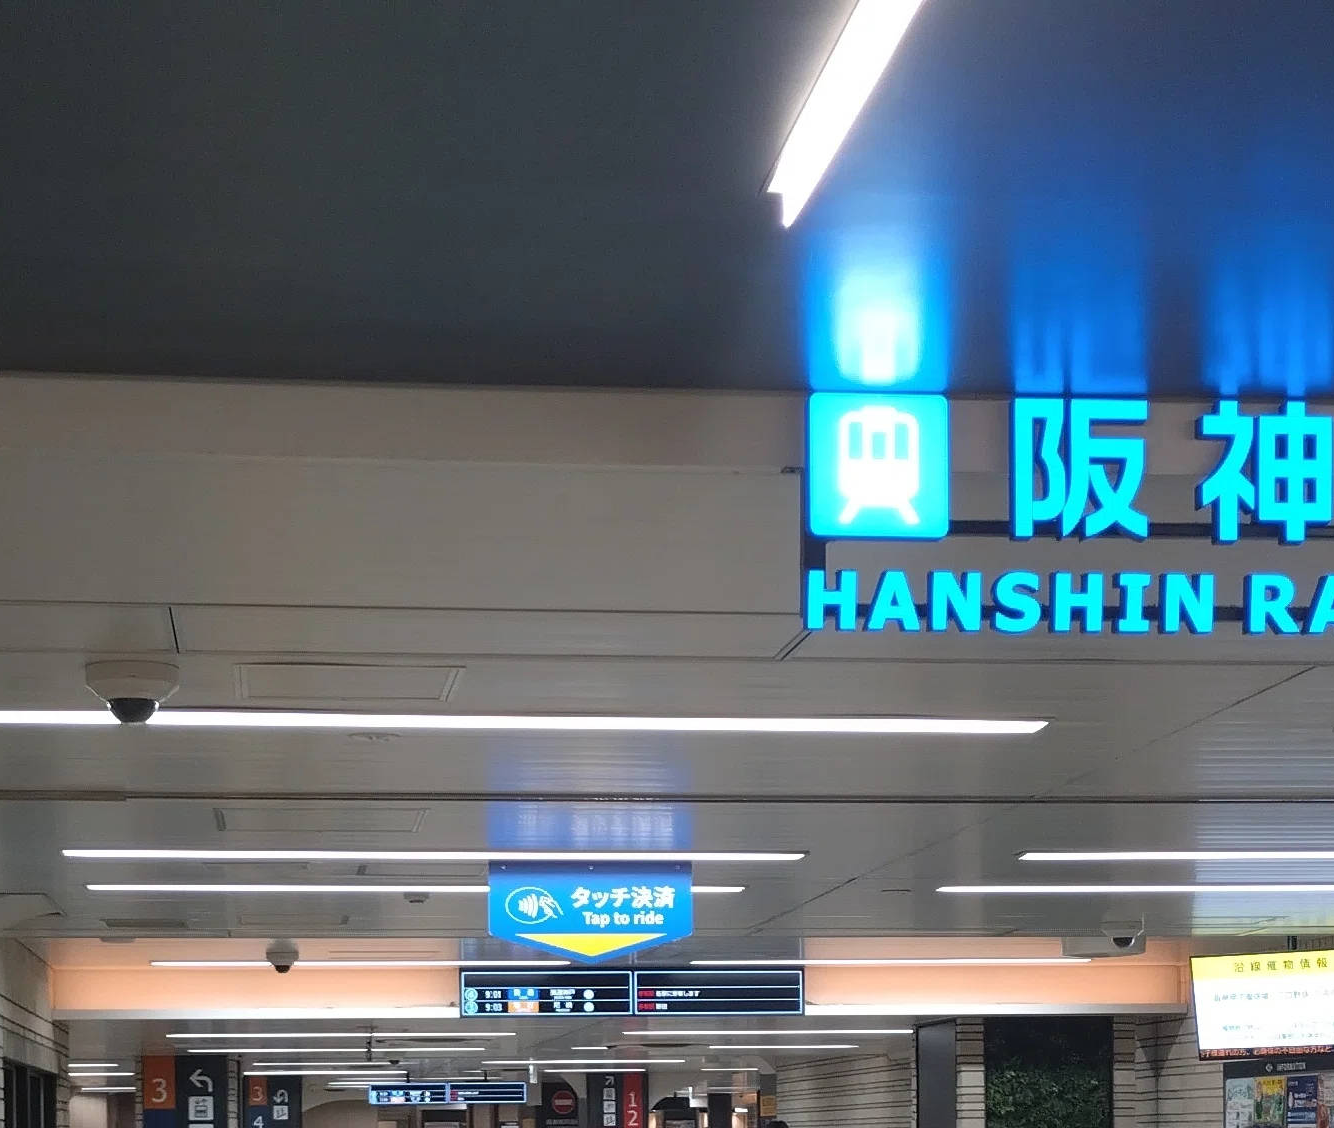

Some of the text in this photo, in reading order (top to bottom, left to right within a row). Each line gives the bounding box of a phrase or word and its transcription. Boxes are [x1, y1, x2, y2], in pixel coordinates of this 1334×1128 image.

[806, 568, 1216, 636] HANSHIN
[570, 886, 676, 909] タッチ決済
[582, 911, 664, 928] Tap to ride
[151, 1077, 168, 1103] 3
[252, 1085, 264, 1101] 3
[629, 1091, 638, 1108] 1
[627, 1110, 639, 1127] 2
